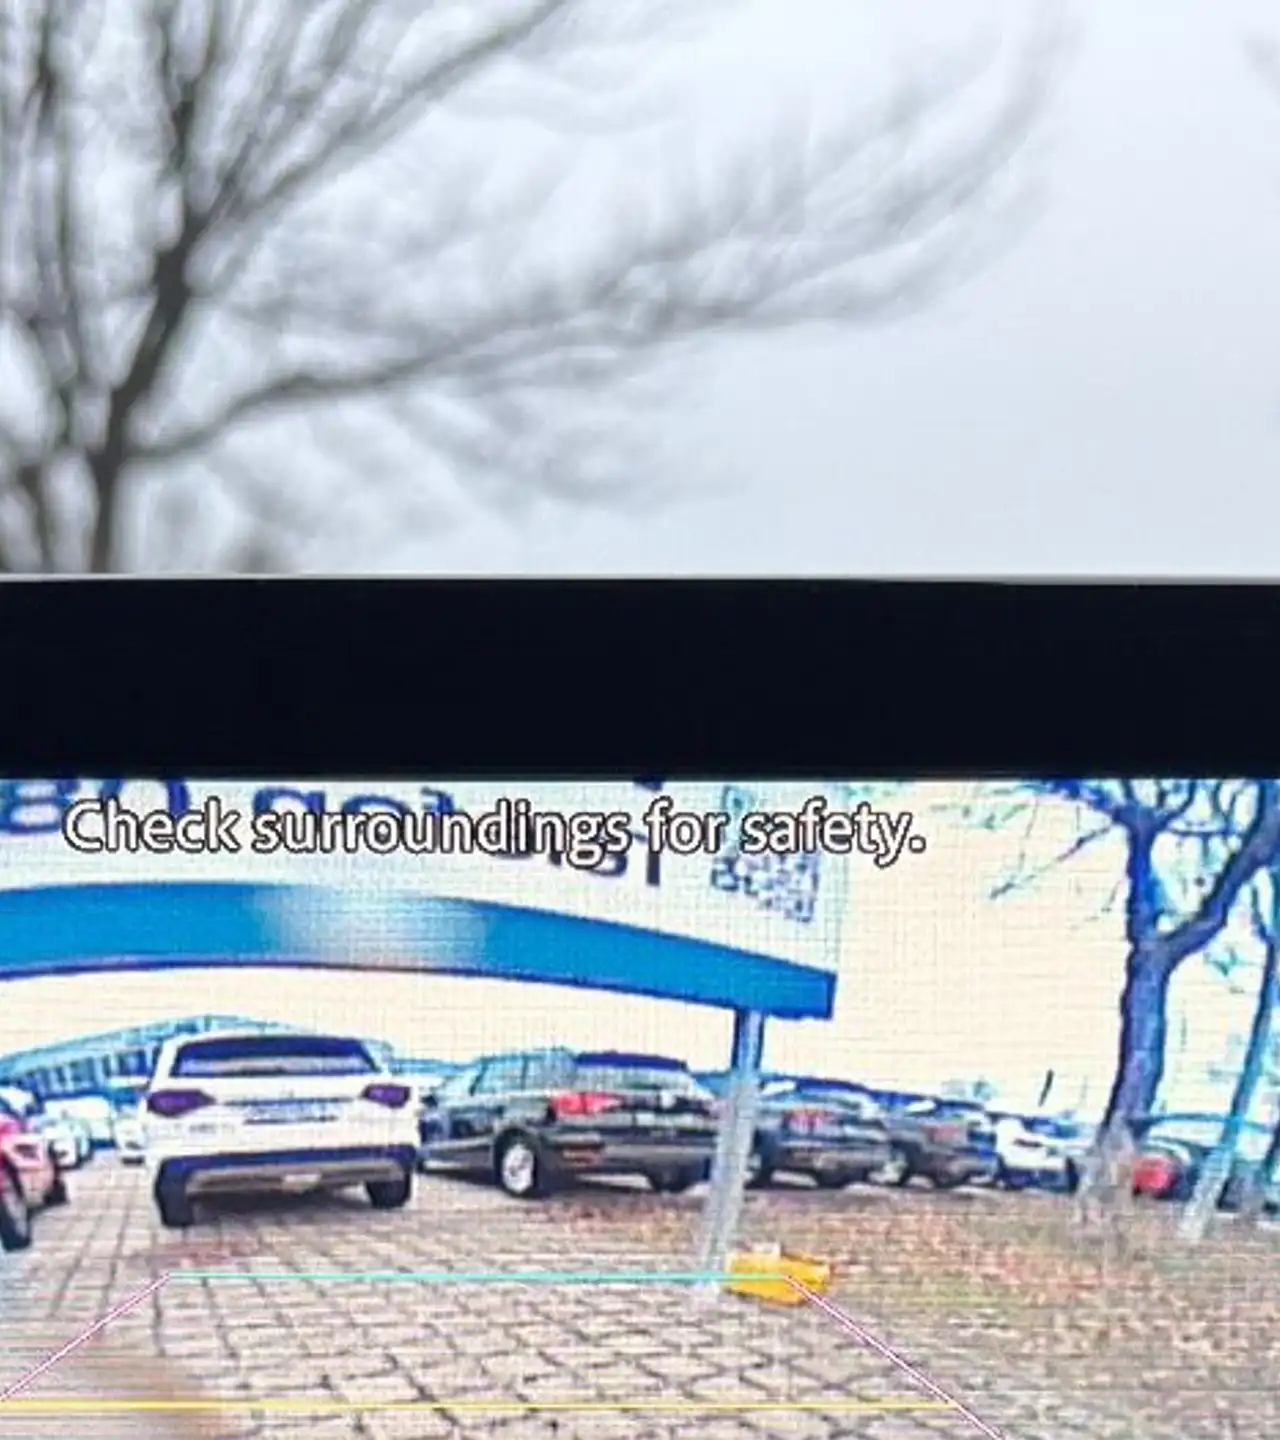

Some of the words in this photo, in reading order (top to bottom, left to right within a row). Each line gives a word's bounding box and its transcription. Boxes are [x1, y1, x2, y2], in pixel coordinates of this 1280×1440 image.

[62, 794, 242, 854] Check
[251, 796, 633, 869] surroundings
[644, 796, 729, 854] for
[740, 796, 926, 868] safety.
